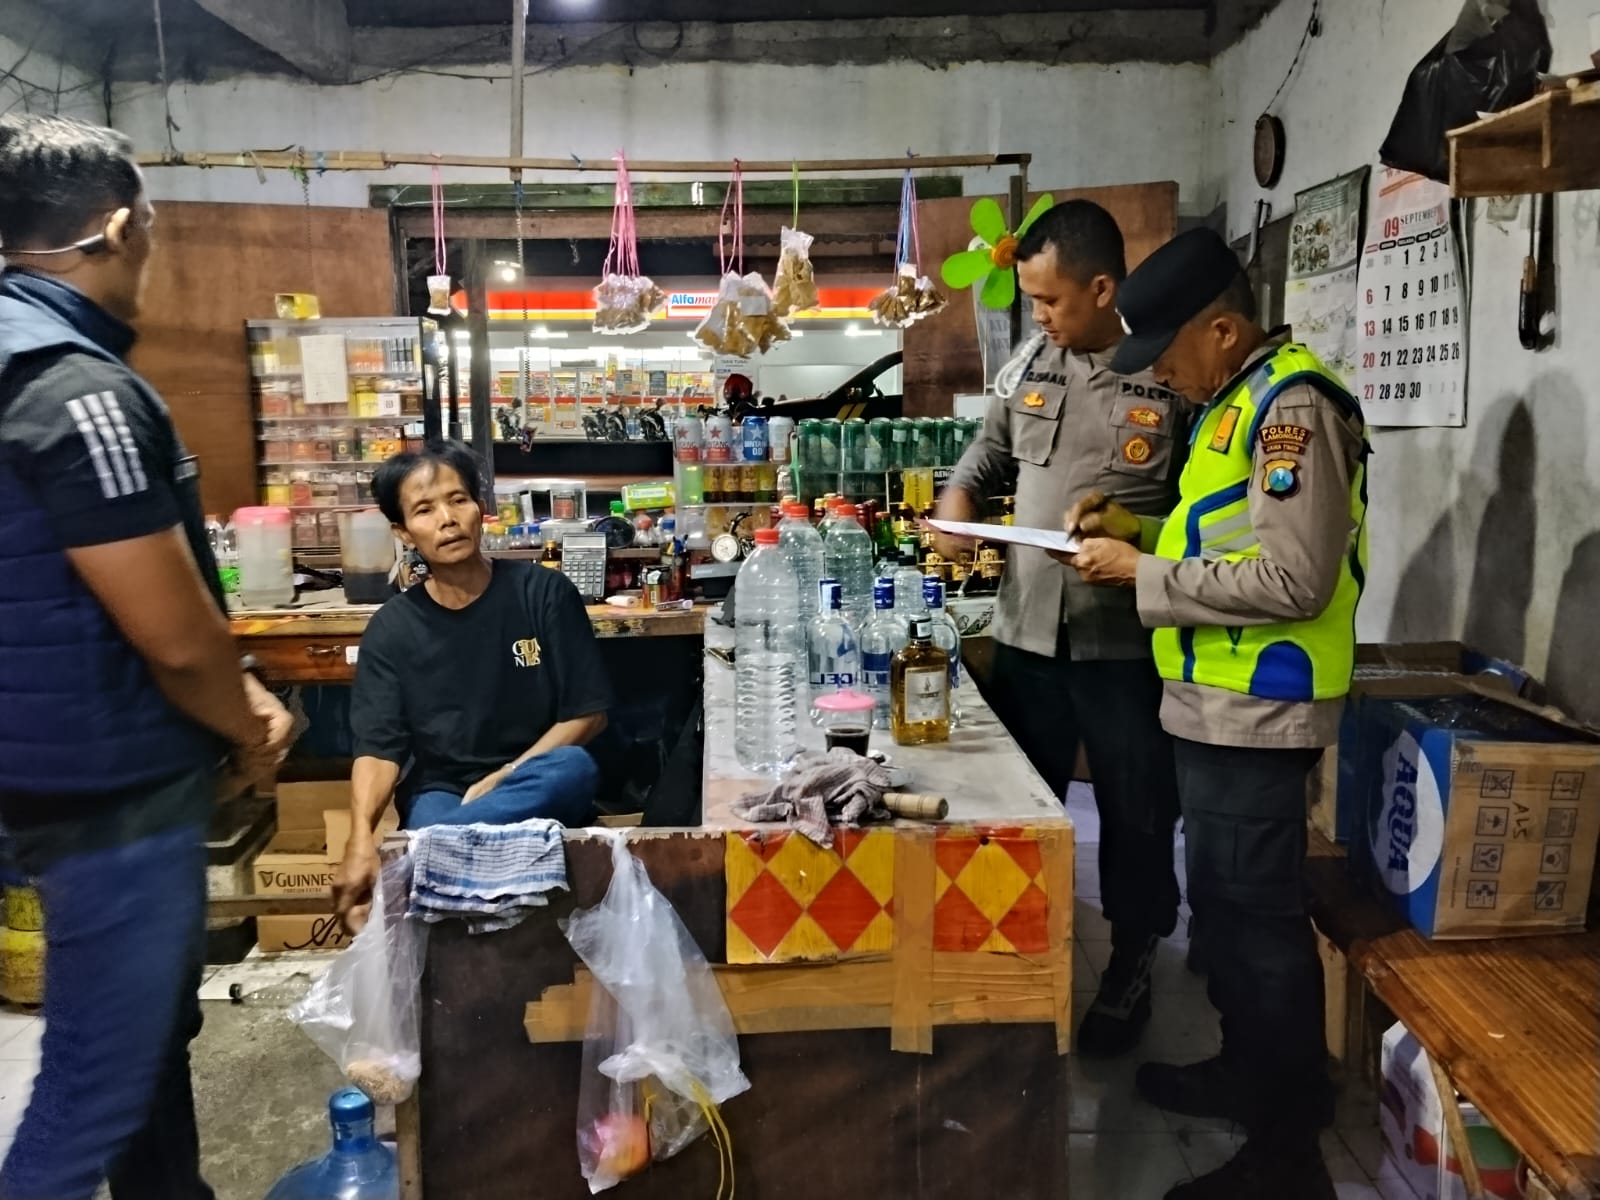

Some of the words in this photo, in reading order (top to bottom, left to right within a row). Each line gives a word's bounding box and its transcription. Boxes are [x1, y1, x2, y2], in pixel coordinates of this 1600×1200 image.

[1384, 216, 1399, 238] 09
[1400, 207, 1437, 225] SEPTEMBER
[1404, 249, 1409, 265] 1
[1419, 245, 1425, 262] 2
[1434, 241, 1439, 258] 3
[1366, 289, 1373, 305] 6
[1384, 285, 1390, 301] 7
[1402, 282, 1408, 299] 8
[1418, 279, 1424, 296] 9
[1430, 275, 1439, 293] 10
[1443, 273, 1449, 290] 11
[1364, 320, 1375, 336] 13
[1382, 318, 1392, 334] 14
[1398, 315, 1409, 332] 15
[1415, 313, 1424, 330] 16
[1429, 310, 1437, 328] 17
[1441, 307, 1449, 326] 18
[1363, 352, 1375, 368] 20
[1380, 351, 1391, 367] 21
[1396, 349, 1408, 365] 22
[1412, 347, 1423, 364] 23
[1426, 345, 1435, 362] 24
[1440, 343, 1449, 361] 25
[1452, 341, 1459, 360] 26
[1364, 384, 1374, 400] 27
[1379, 383, 1391, 400] 28
[1394, 382, 1406, 399] 29
[1409, 381, 1421, 399] 30
[1261, 426, 1306, 437] POLRES
[1387, 752, 1418, 872] AQUA
[275, 872, 334, 888] GUINNES
